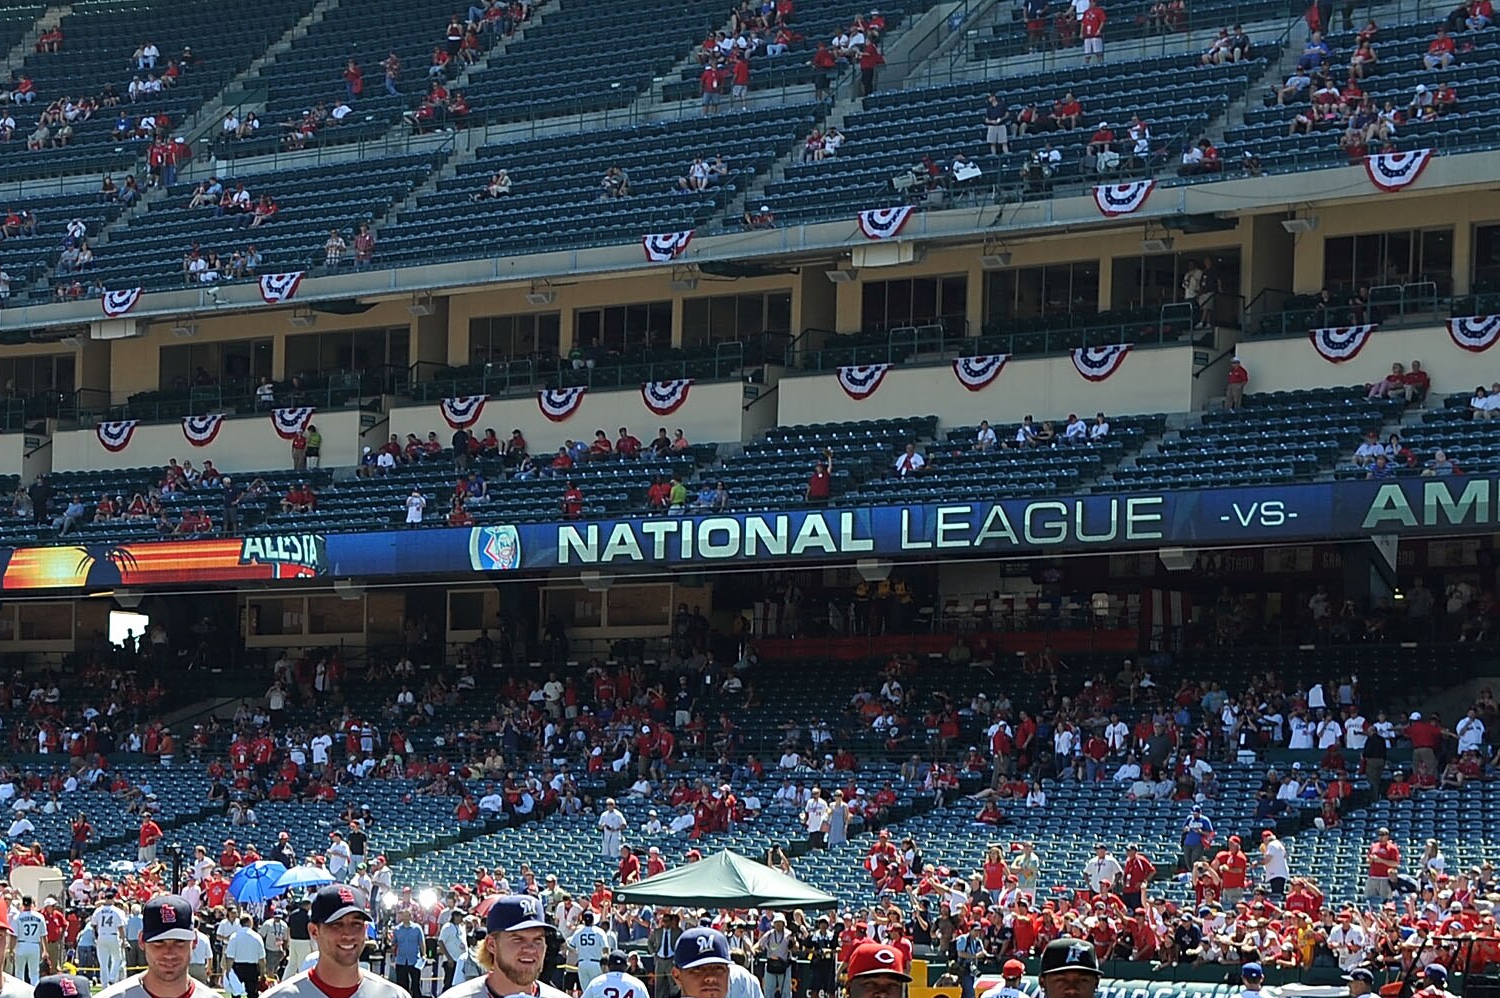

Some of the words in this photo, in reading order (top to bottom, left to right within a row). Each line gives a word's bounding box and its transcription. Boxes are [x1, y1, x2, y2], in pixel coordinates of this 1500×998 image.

[1361, 478, 1500, 528] AM
[557, 512, 874, 566] NATIONAL
[901, 497, 1163, 549] LEAGUE
[520, 900, 536, 915] M
[100, 915, 113, 927] 14
[23, 923, 39, 937] 37
[580, 933, 596, 946] 65
[696, 936, 714, 953] M
[873, 949, 895, 964] C
